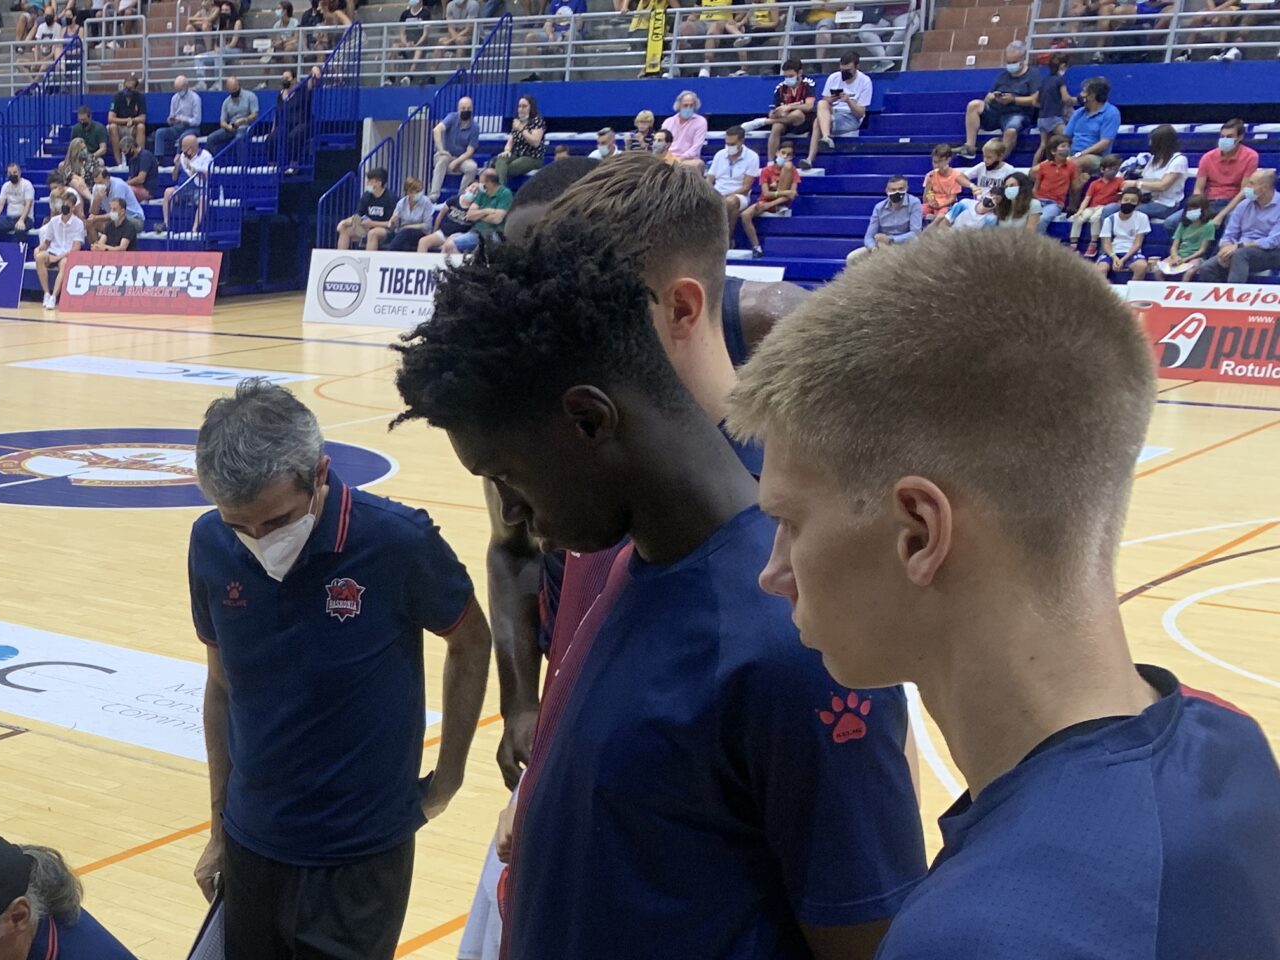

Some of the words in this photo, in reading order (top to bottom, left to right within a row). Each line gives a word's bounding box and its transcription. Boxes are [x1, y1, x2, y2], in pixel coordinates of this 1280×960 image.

[66, 265, 214, 298] GIGANTES
[325, 282, 360, 293] VOLVO
[1164, 286, 1192, 301] Tu
[1201, 287, 1280, 306] Mejo
[374, 305, 407, 316] GETAFE
